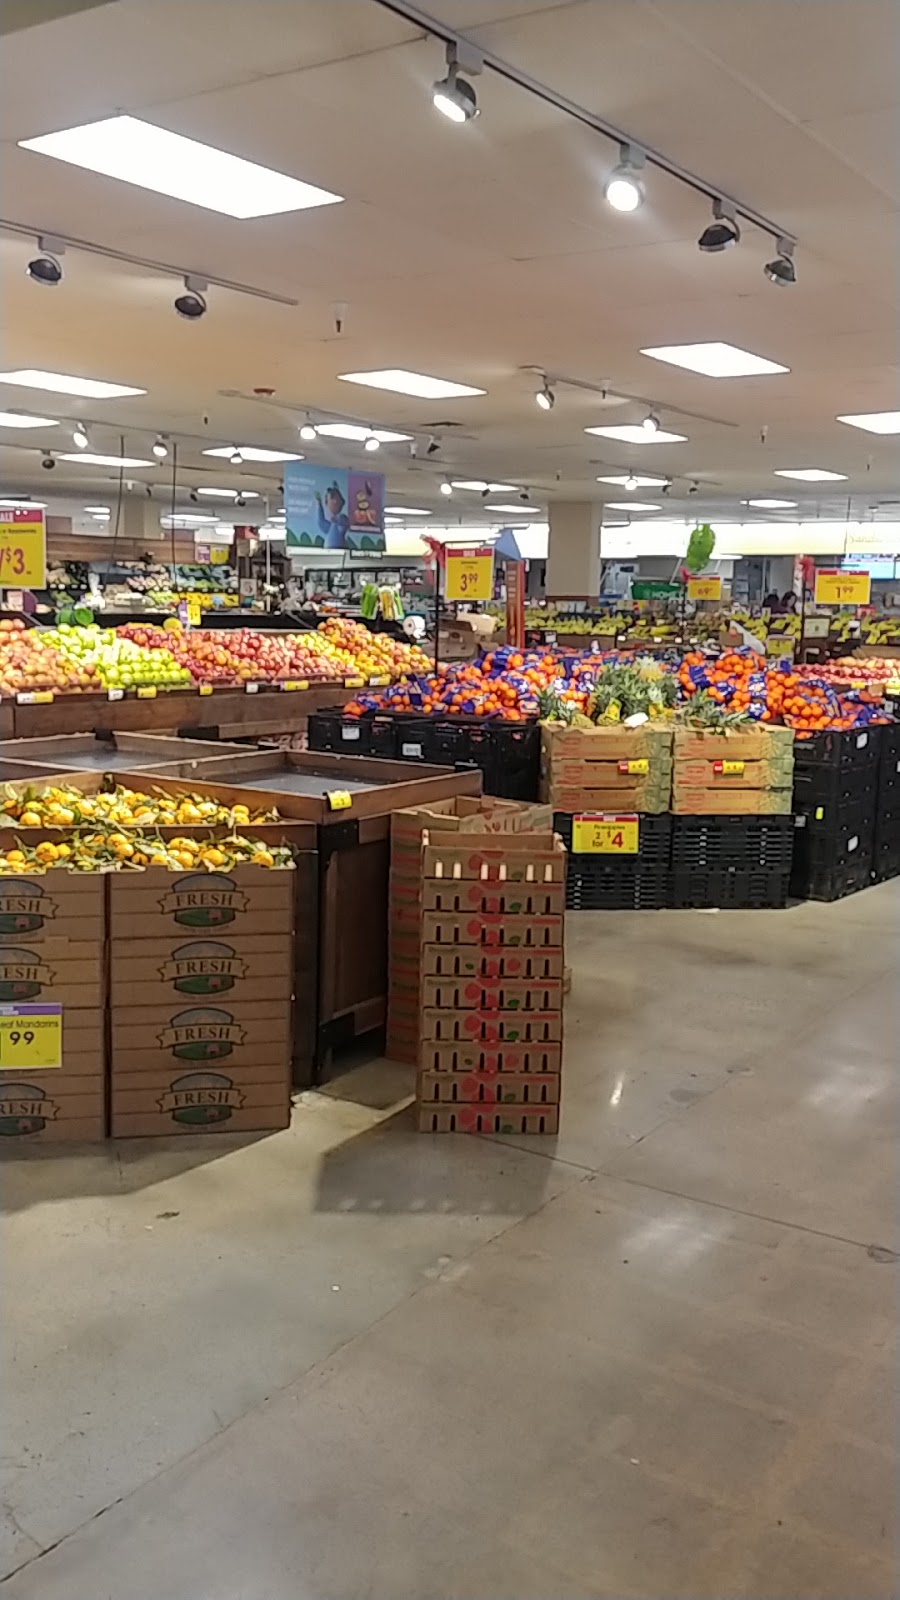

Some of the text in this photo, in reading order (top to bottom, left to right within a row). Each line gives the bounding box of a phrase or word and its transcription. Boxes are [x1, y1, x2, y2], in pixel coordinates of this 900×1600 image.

[596, 831, 601, 840] 2
[175, 892, 234, 907] FRESH
[0, 967, 37, 979] ESH
[175, 959, 233, 975] FRESH
[16, 1019, 59, 1028] Mandarins
[173, 1026, 231, 1042] FRESH
[173, 1091, 230, 1107] FRESH
